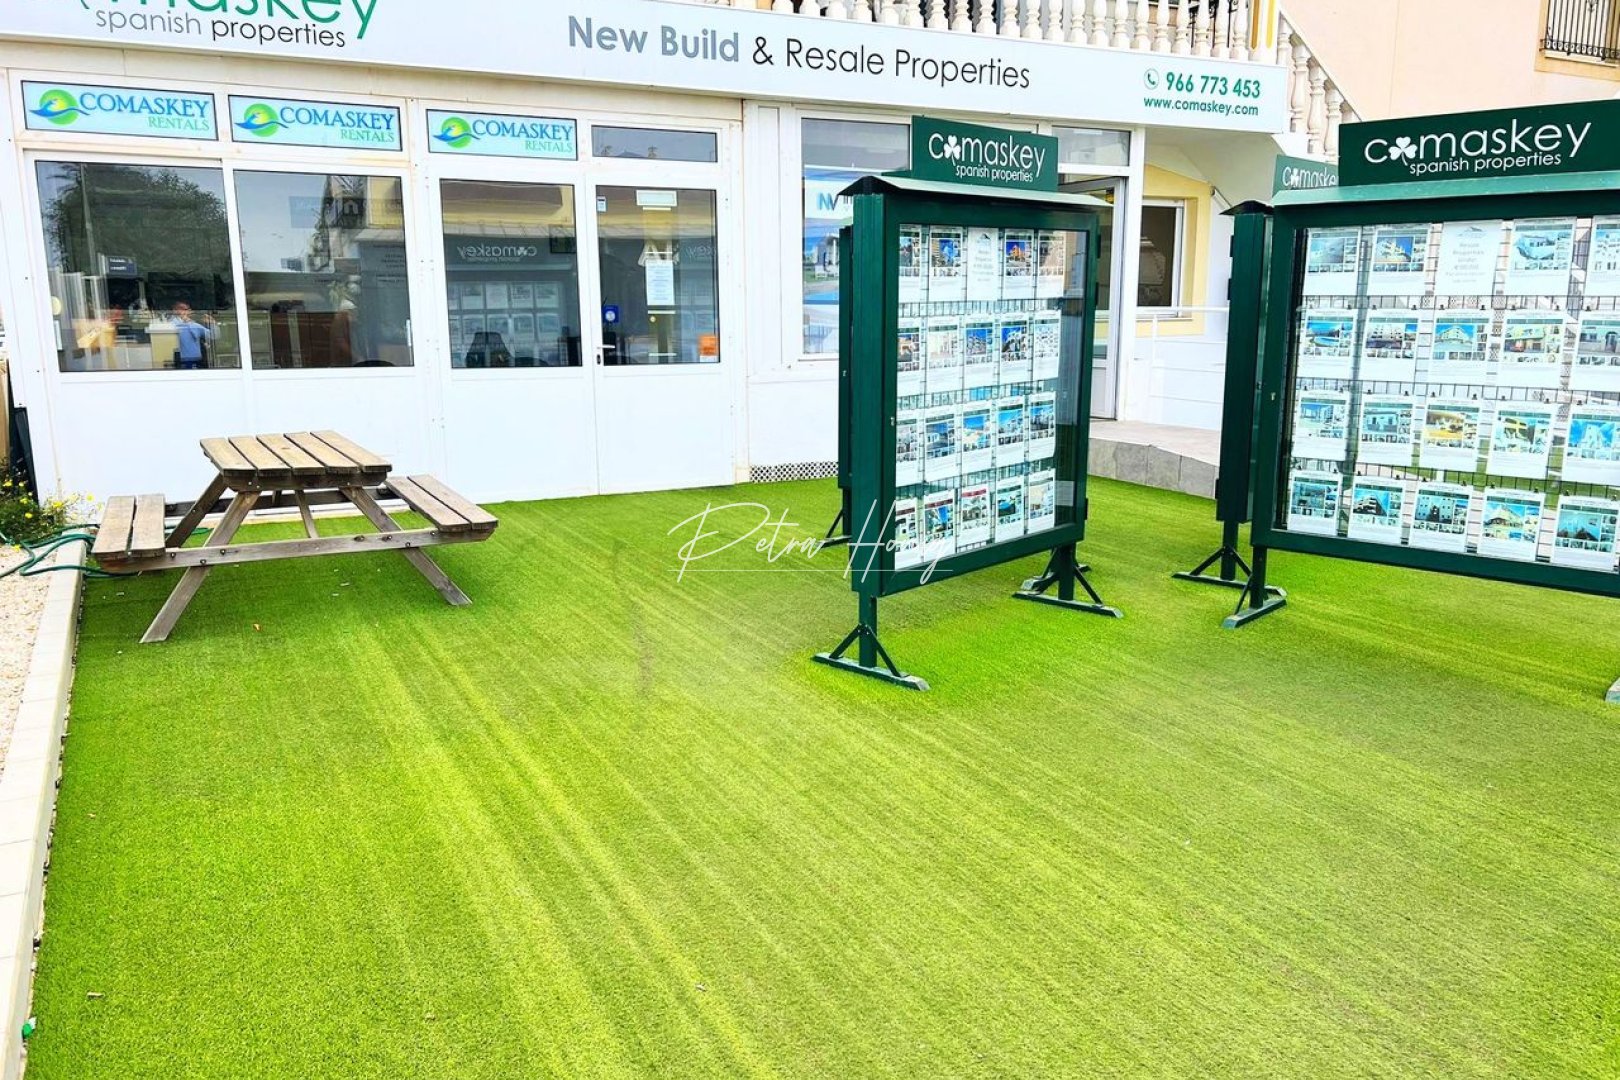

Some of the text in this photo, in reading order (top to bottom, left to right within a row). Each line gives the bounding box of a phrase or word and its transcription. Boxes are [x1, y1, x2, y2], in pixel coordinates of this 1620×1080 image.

[96, 9, 202, 34] spanish
[211, 20, 346, 48] properties
[568, 15, 1031, 89] New Build & Resale Properties
[1166, 71, 1261, 98] 966 773 453
[79, 92, 210, 119] COMASKEY
[1143, 97, 1259, 116] www.comaskey.com
[148, 116, 210, 132] RENTALS
[279, 106, 395, 131] COMASKEY
[472, 119, 574, 142] COMASKEY
[340, 128, 395, 143] RENTALS
[524, 140, 574, 153] RENTALS
[955, 164, 1034, 182] spanish properties
[1409, 151, 1562, 177] spanish properties
